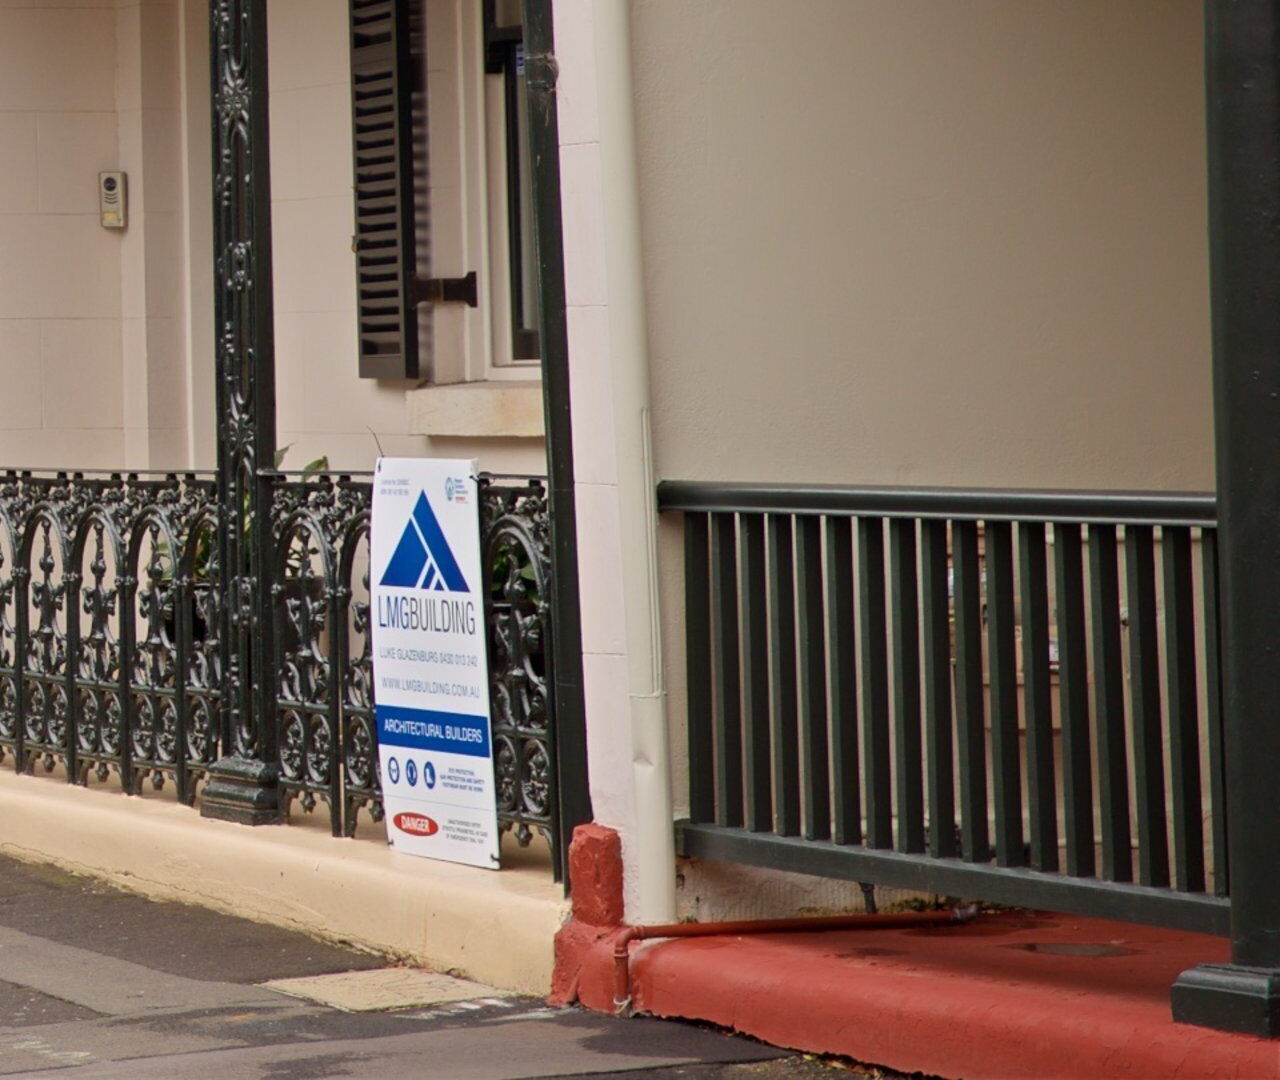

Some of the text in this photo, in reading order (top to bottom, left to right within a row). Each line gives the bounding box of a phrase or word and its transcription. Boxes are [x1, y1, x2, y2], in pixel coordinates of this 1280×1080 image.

[378, 595, 476, 635] LMGBUILDING
[379, 648, 396, 659] LUKE
[384, 719, 483, 743] ARCHITECTURAL BUILDERS
[401, 815, 430, 832] DANGER
